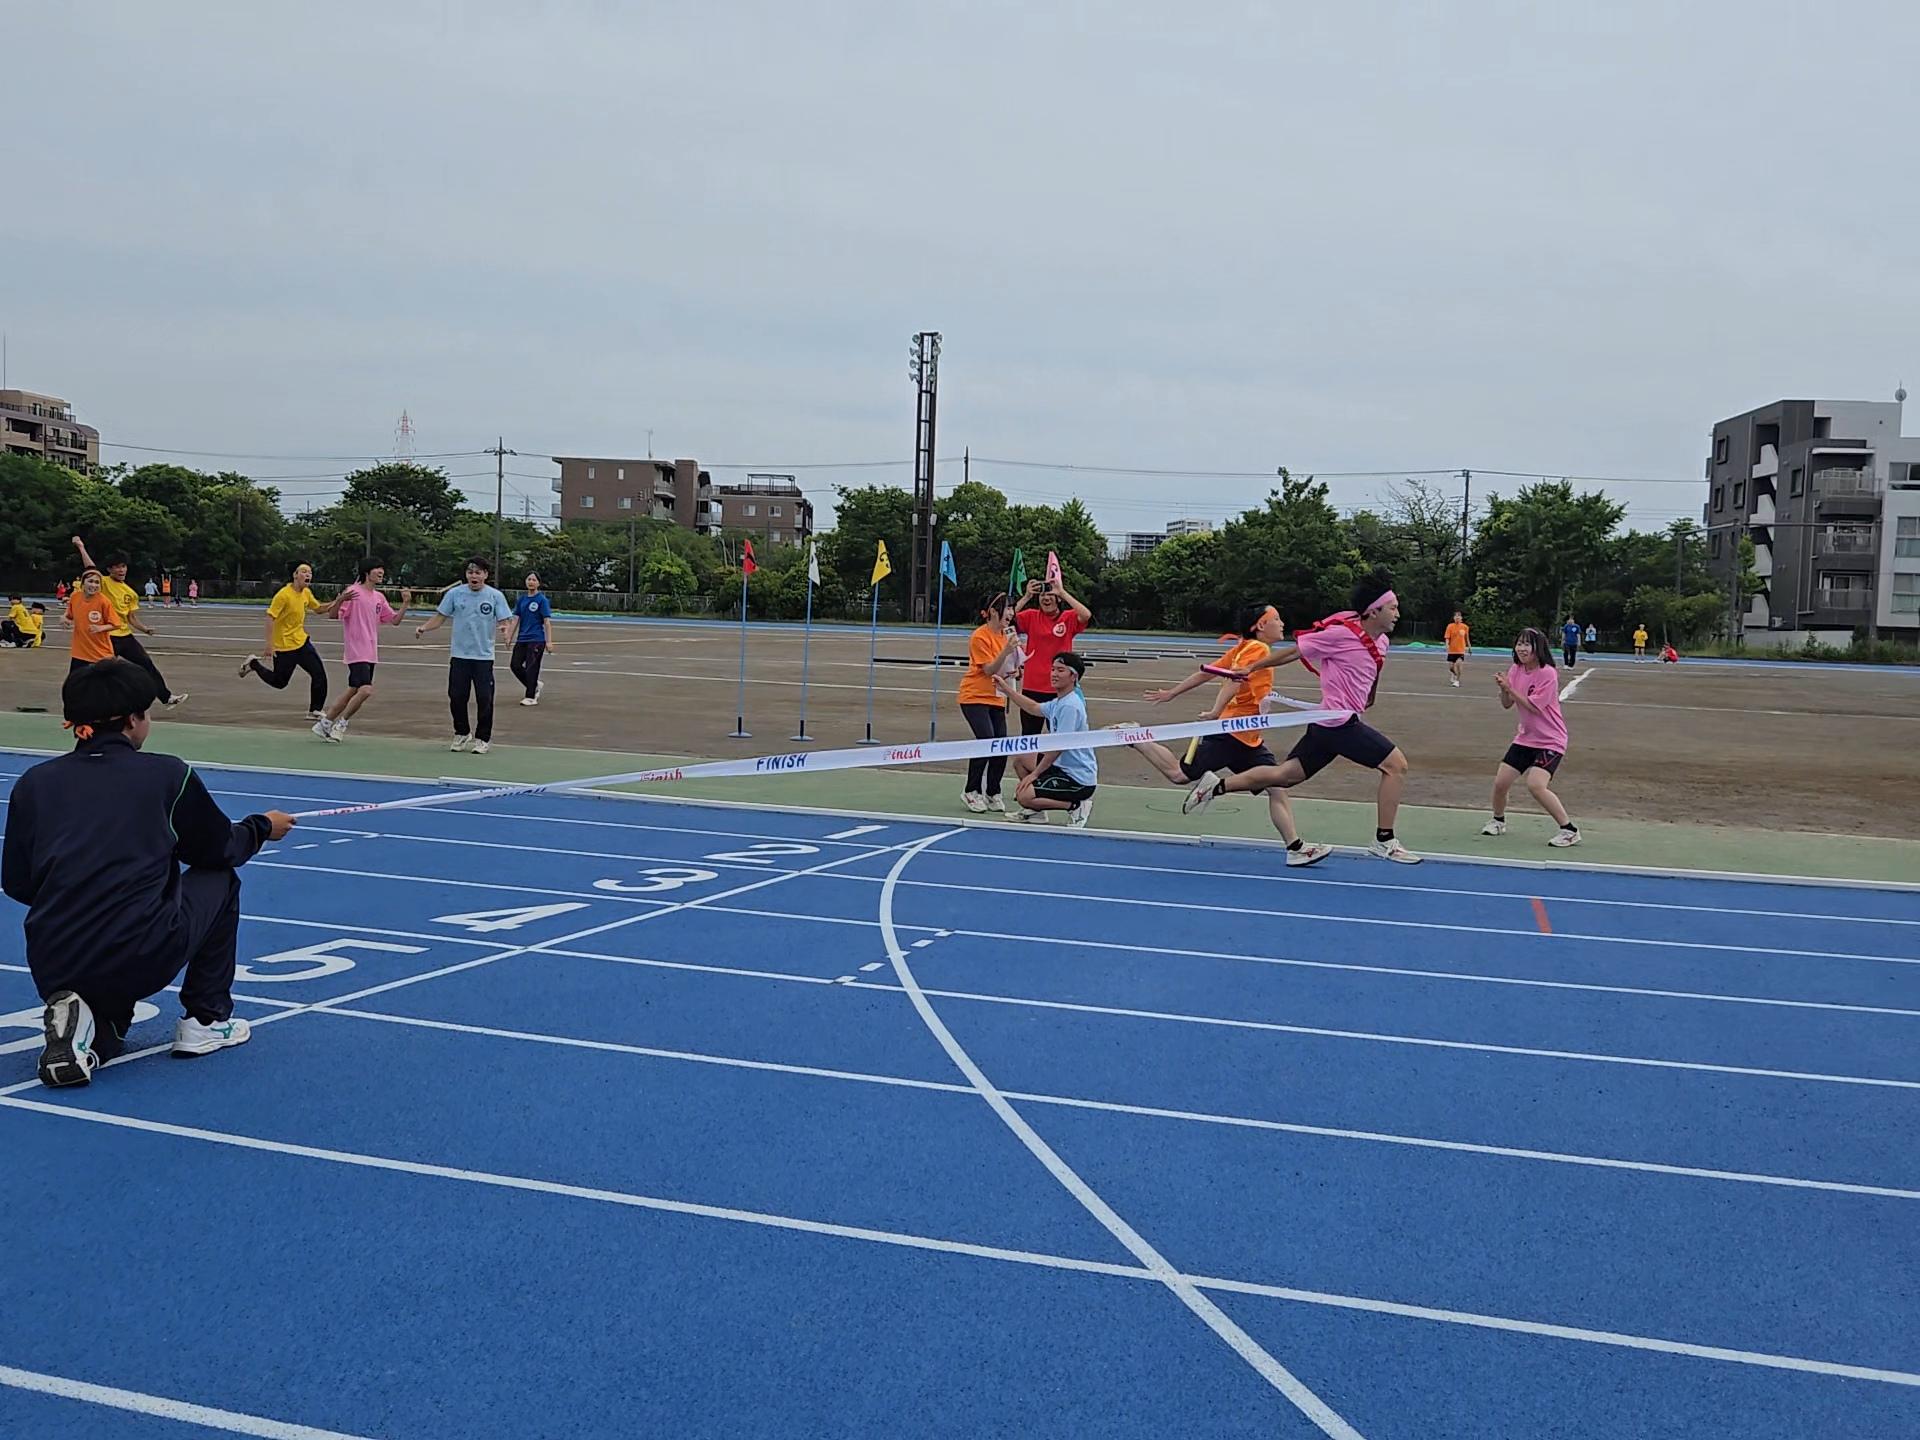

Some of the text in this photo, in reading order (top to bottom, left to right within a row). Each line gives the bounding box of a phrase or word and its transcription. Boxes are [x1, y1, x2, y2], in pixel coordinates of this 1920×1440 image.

[756, 753, 808, 771] FINISH
[990, 737, 1039, 753] FINISH
[1221, 715, 1270, 731] FINISH
[824, 825, 889, 840] 1
[703, 843, 820, 864] 2
[592, 868, 719, 892] 3
[430, 902, 592, 932] 4
[235, 938, 431, 982] 5
